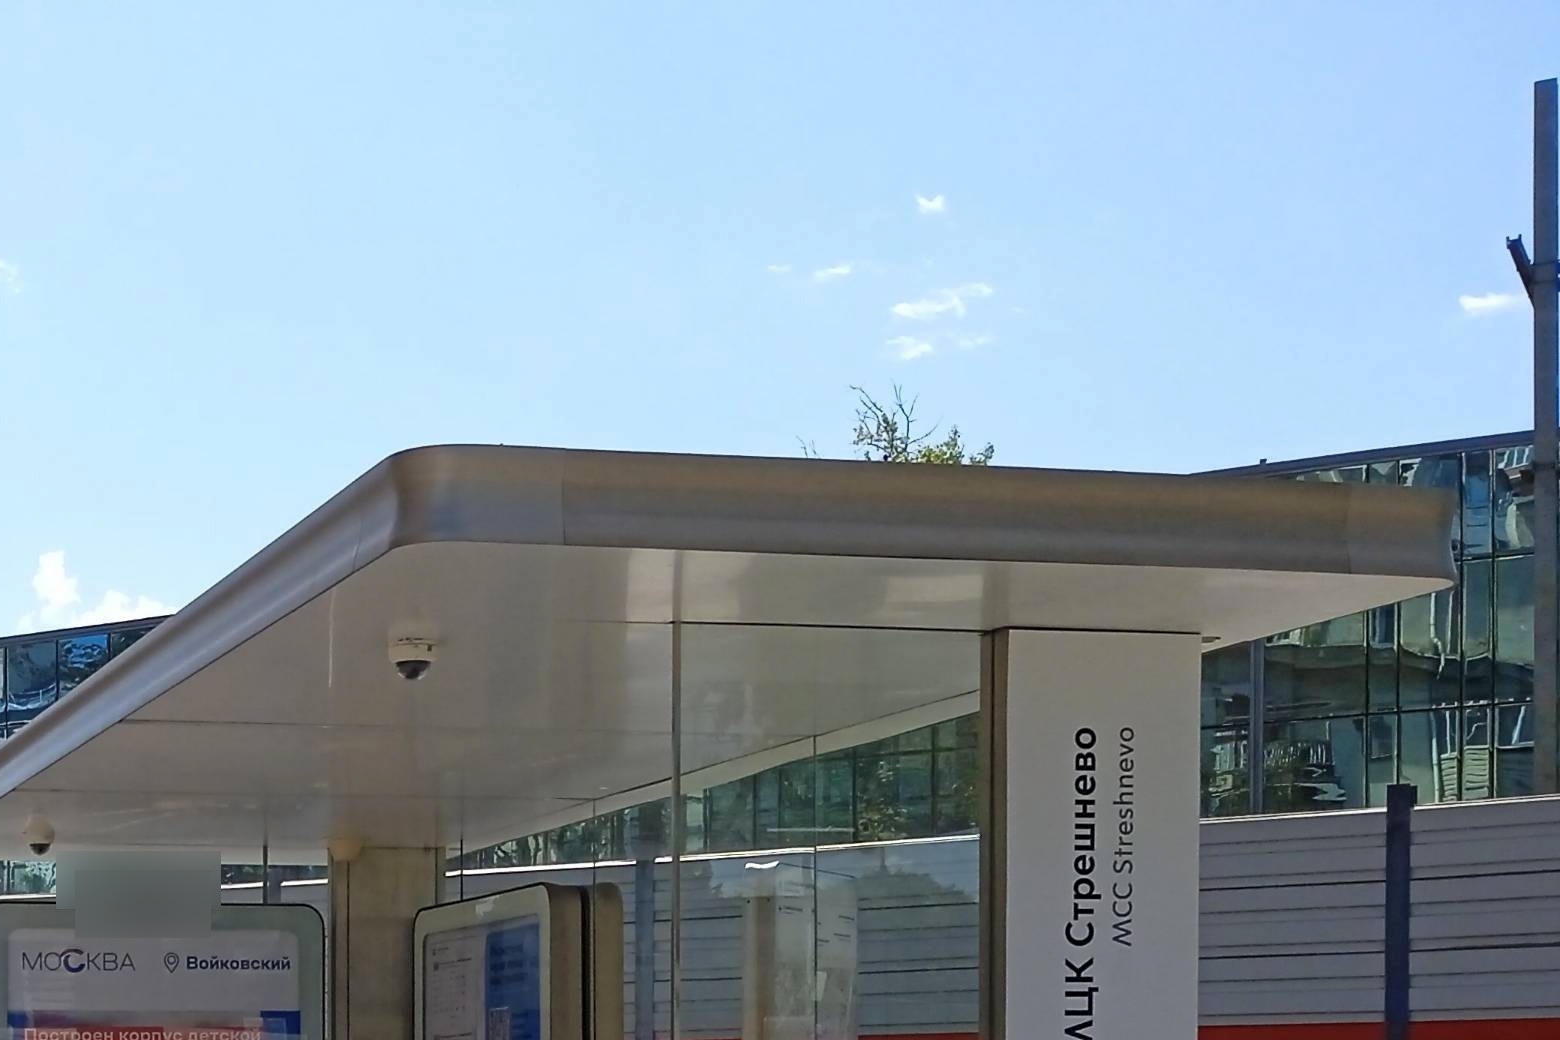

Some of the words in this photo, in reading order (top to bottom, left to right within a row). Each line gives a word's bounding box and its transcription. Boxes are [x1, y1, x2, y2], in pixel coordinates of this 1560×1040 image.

[1113, 726, 1135, 874] Streshnevo
[1065, 727, 1102, 947] Стрешнево
[1112, 882, 1133, 947] MCC
[22, 948, 136, 973] МОСКВА
[186, 955, 291, 971] Войковский
